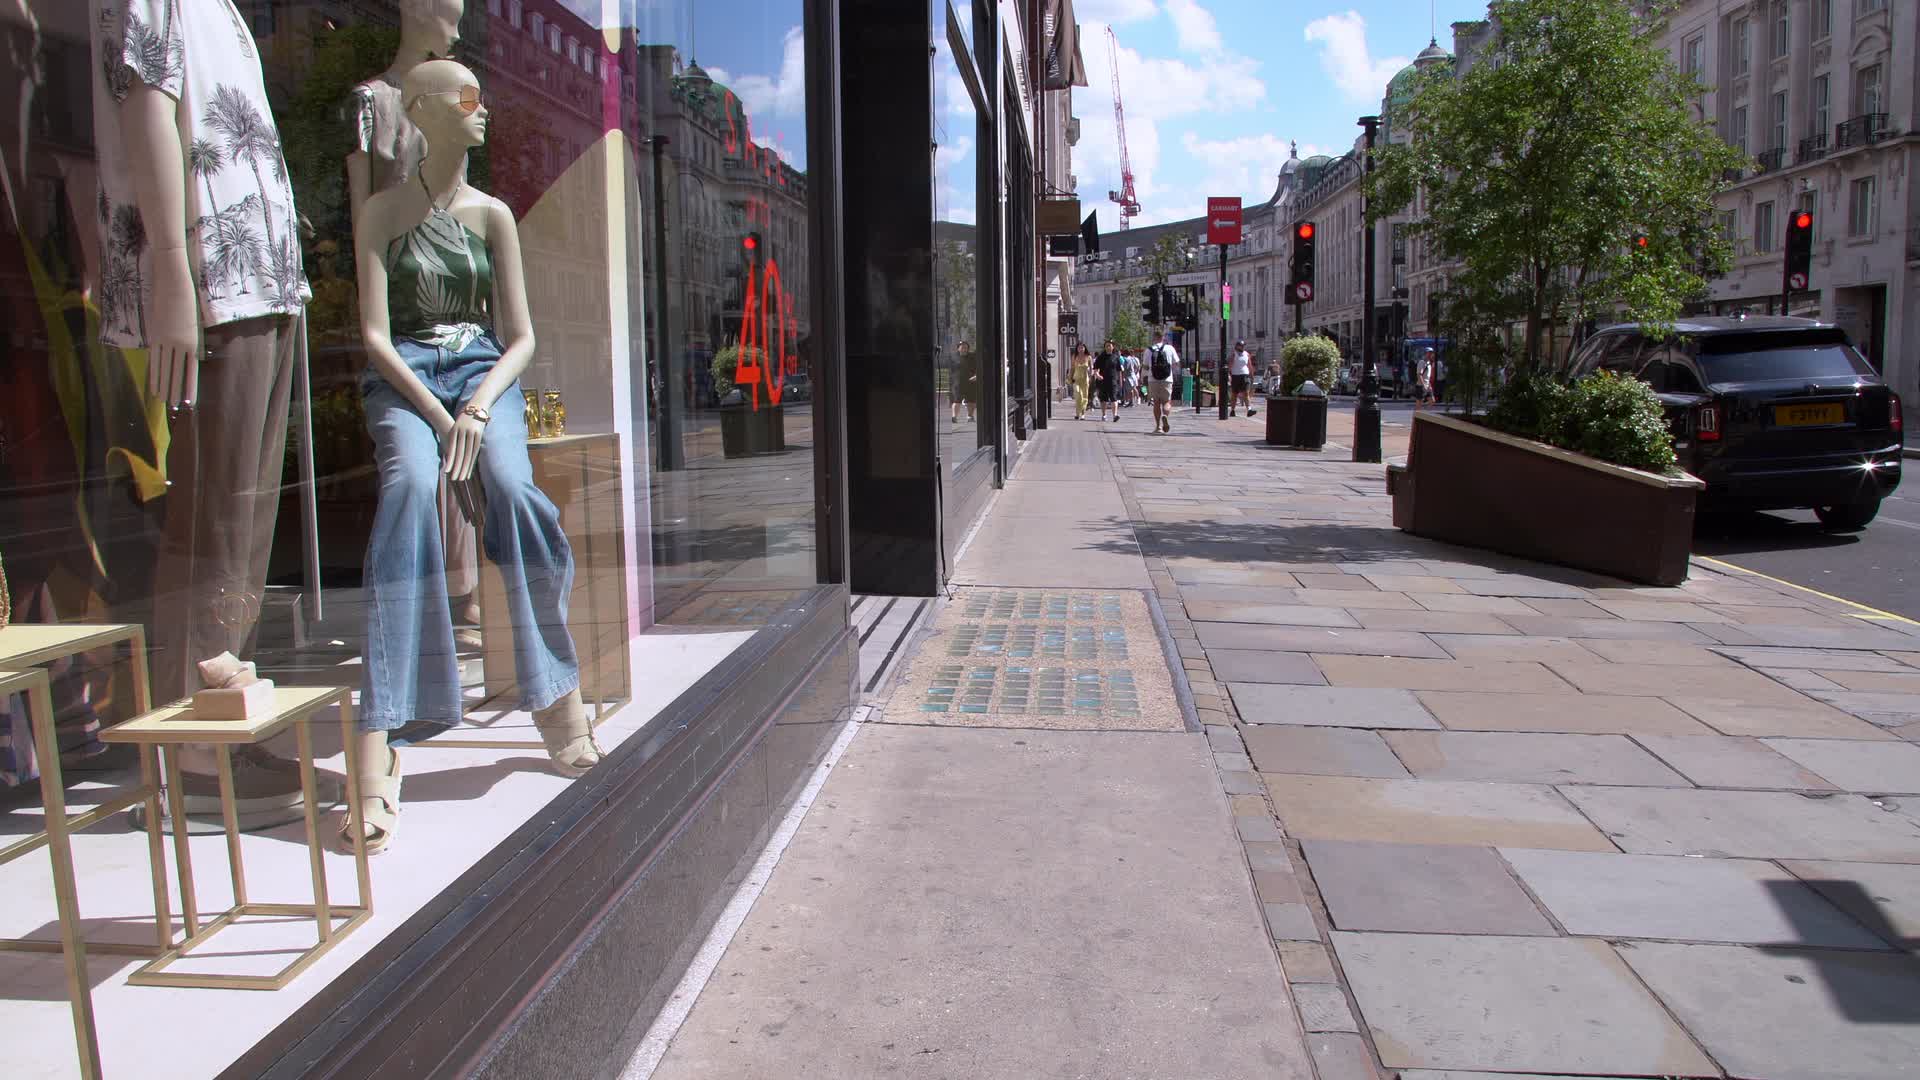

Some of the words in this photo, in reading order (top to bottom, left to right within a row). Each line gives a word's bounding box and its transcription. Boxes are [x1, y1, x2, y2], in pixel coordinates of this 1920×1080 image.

[724, 89, 786, 186] SALE
[735, 258, 784, 412] 40
[1060, 322, 1076, 334] alo
